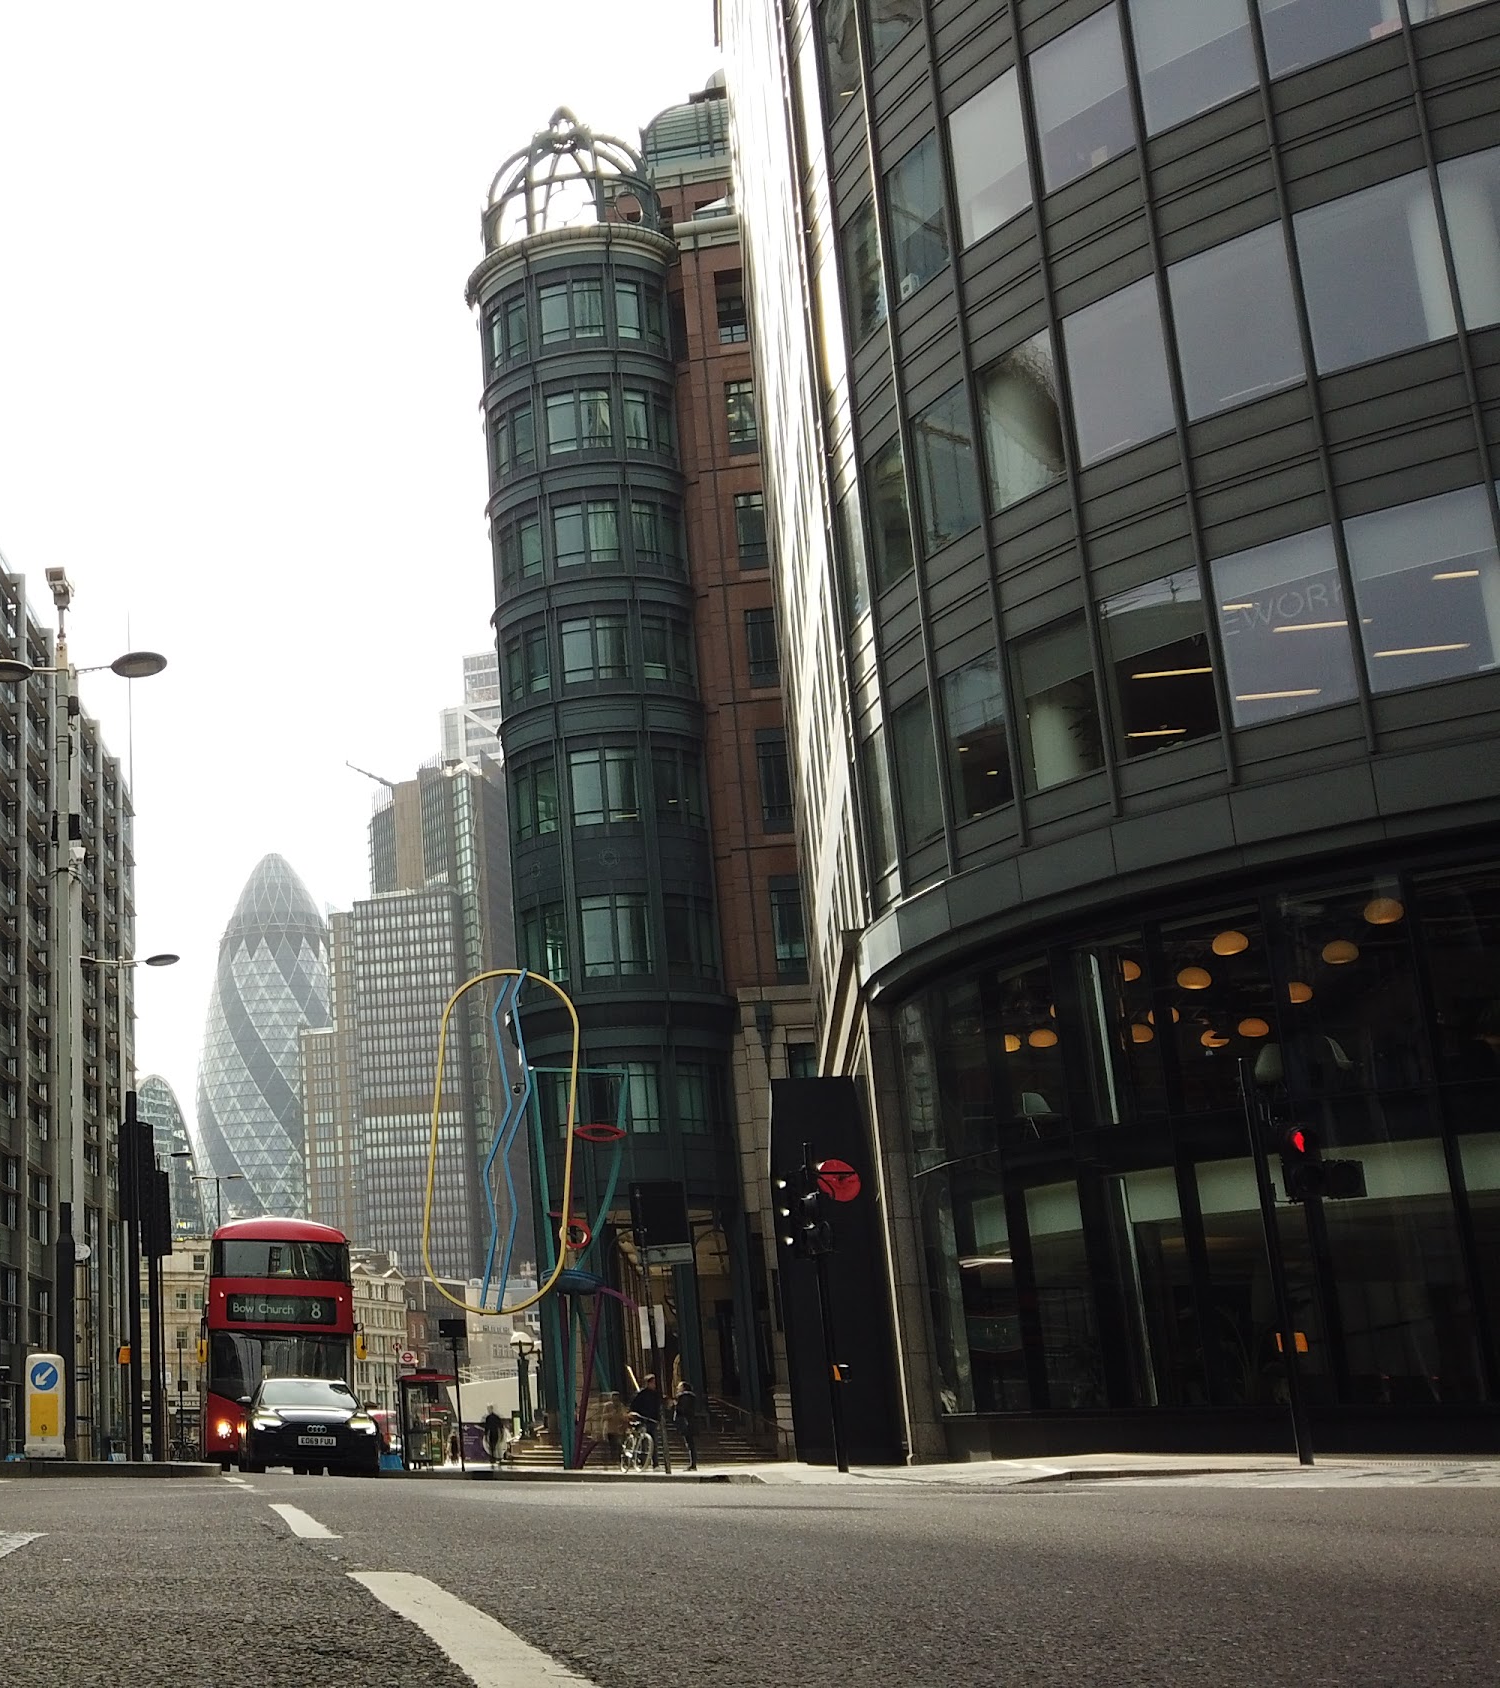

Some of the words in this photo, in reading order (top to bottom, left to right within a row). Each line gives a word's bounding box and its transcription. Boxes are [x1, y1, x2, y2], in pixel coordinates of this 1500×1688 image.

[233, 1302, 254, 1313] Bow
[258, 1303, 294, 1315] Church
[311, 1302, 322, 1319] 8
